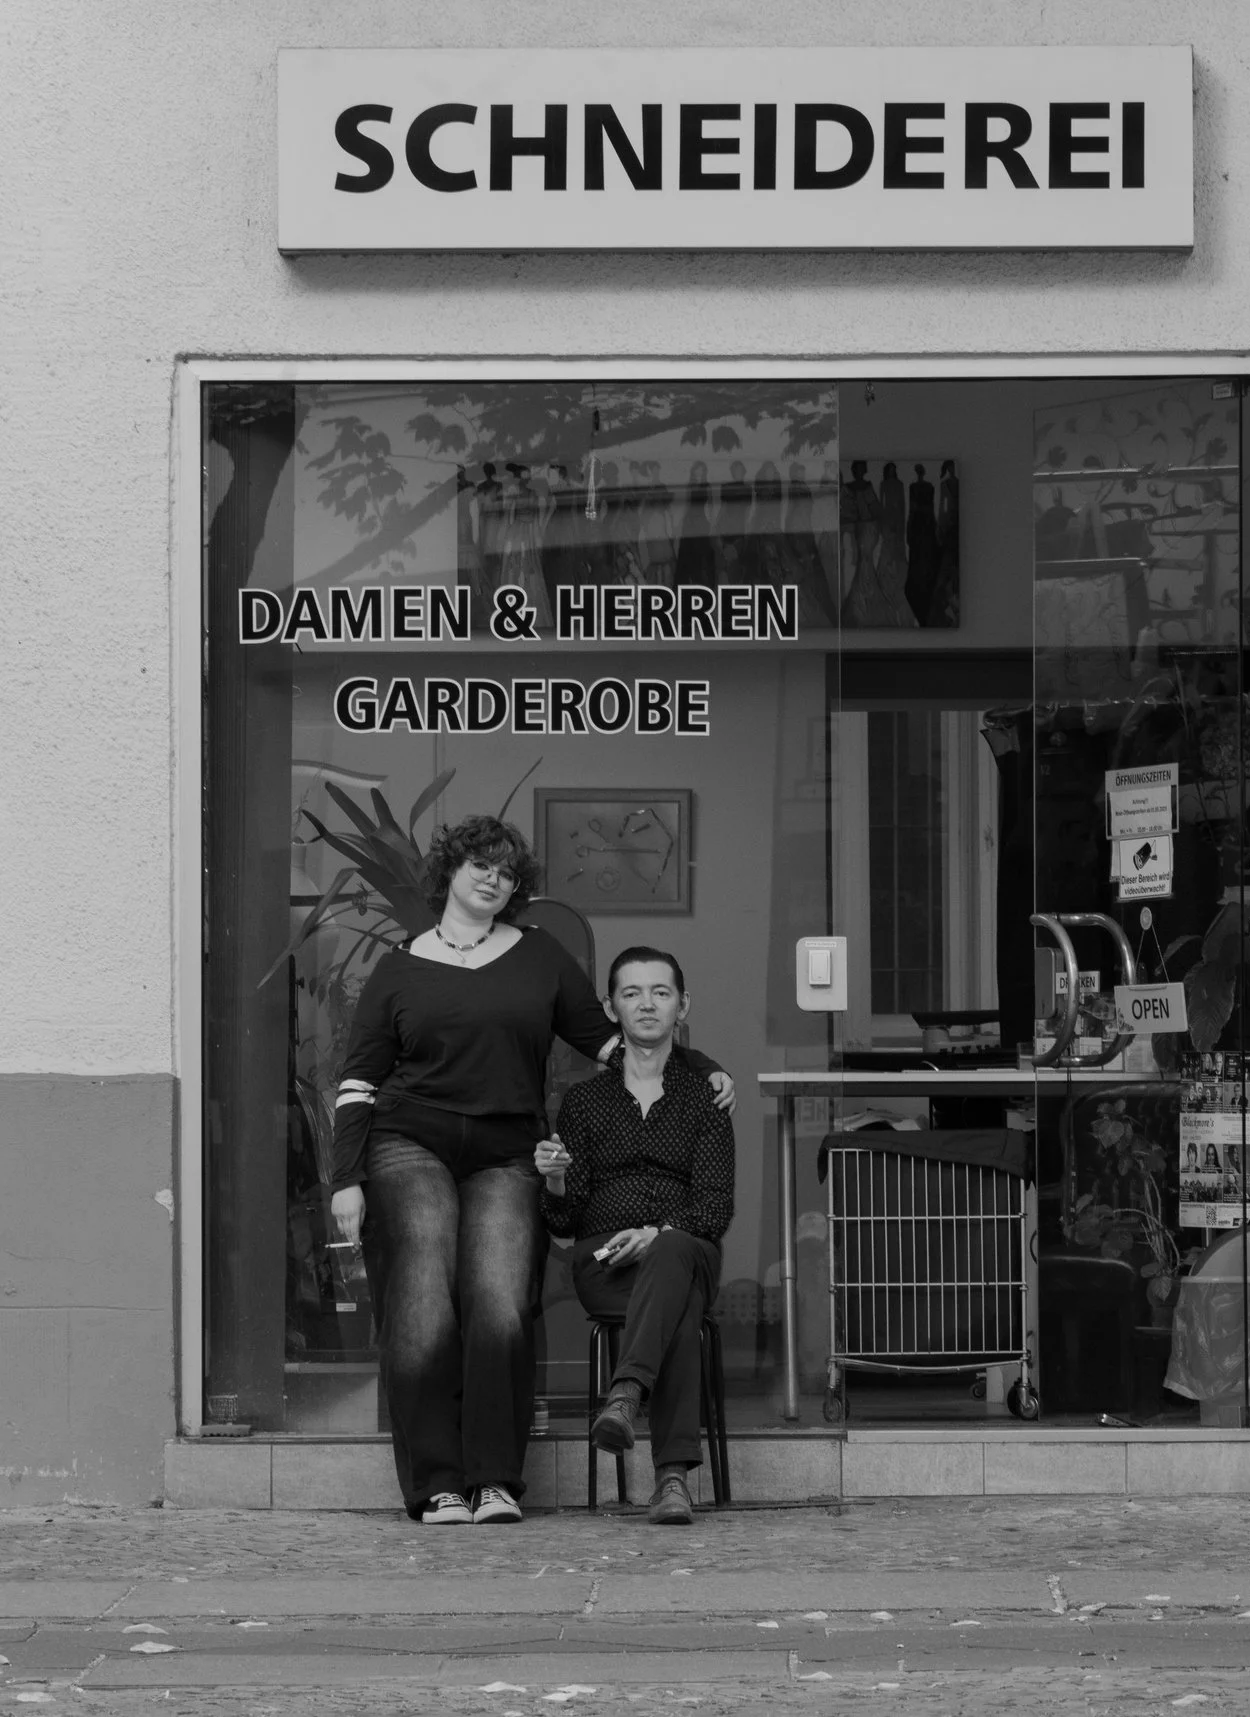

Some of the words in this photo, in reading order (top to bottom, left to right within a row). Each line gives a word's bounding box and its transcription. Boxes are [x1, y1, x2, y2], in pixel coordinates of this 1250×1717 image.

[335, 102, 1145, 193] SCHNEIDEREI
[238, 586, 471, 645] DAMEN
[490, 584, 542, 643] &
[556, 584, 799, 642] HERREN
[333, 677, 711, 737] GARDEROBE
[1115, 770, 1172, 787] ÖFFNUNGSZEITEN
[1121, 875, 1138, 885] Dieser
[1138, 873, 1158, 884] Bereich
[1059, 976, 1096, 989] DKEN
[1131, 997, 1170, 1020] OPEN
